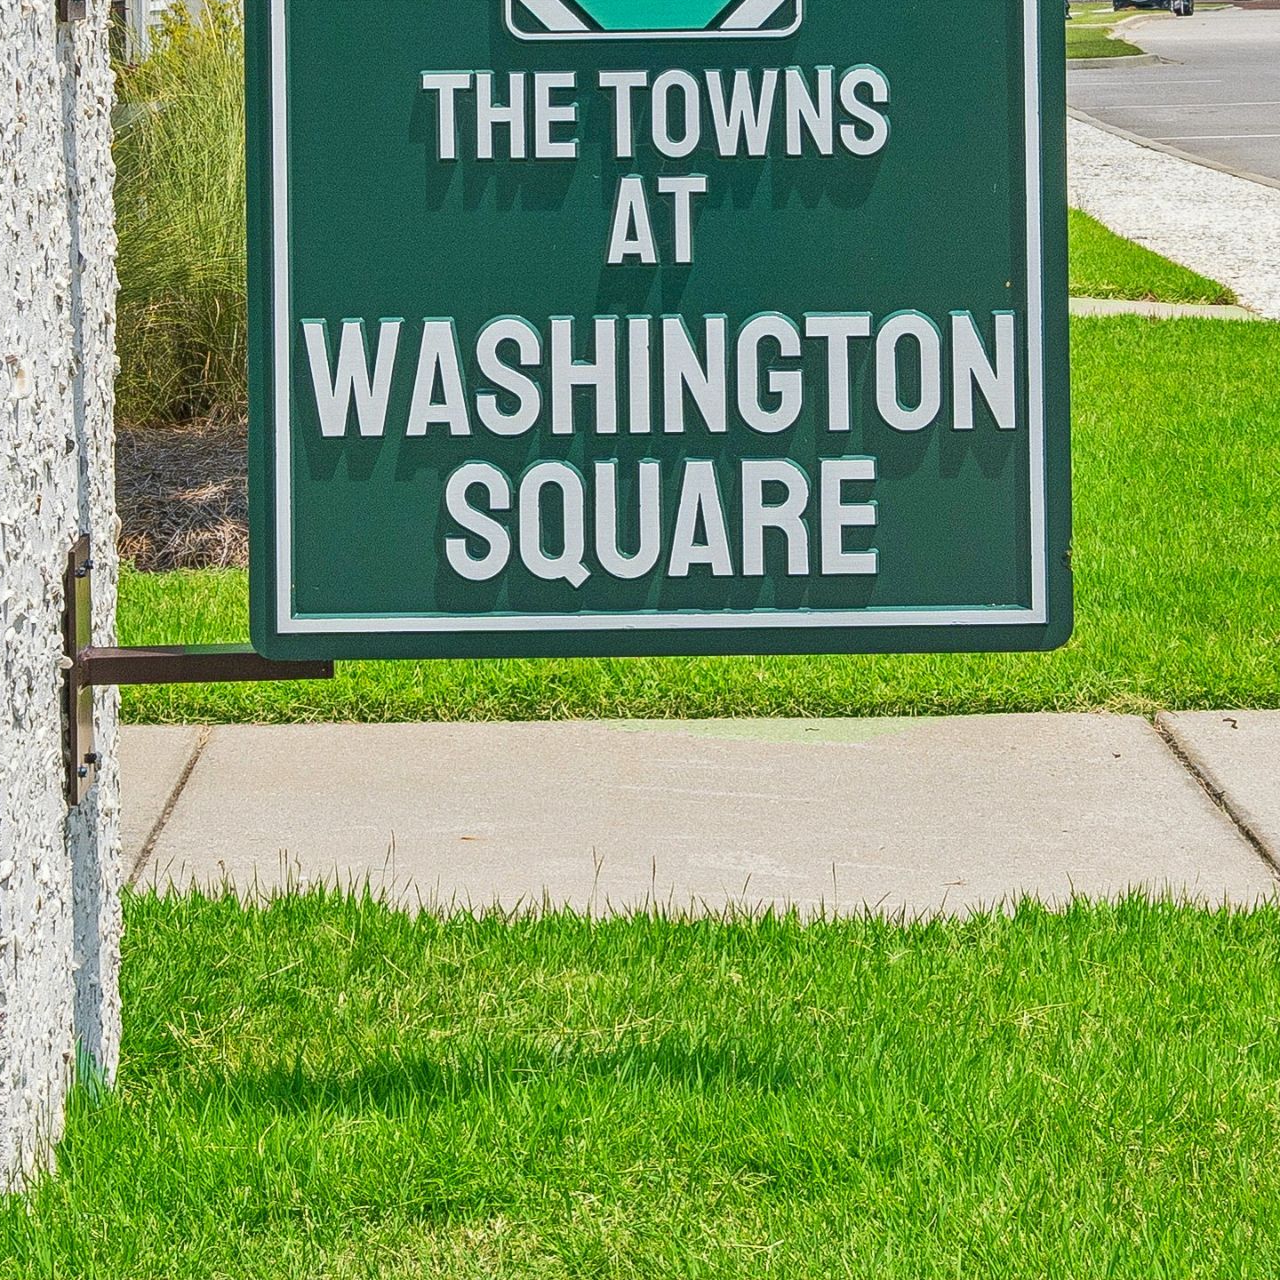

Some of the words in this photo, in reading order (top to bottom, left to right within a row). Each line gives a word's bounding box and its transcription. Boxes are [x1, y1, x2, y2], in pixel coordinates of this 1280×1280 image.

[422, 70, 579, 161] THE
[599, 64, 890, 159] TOWNS
[607, 175, 707, 265] AT
[301, 310, 1016, 438] WASHINGTON
[445, 458, 879, 589] SQUARE
